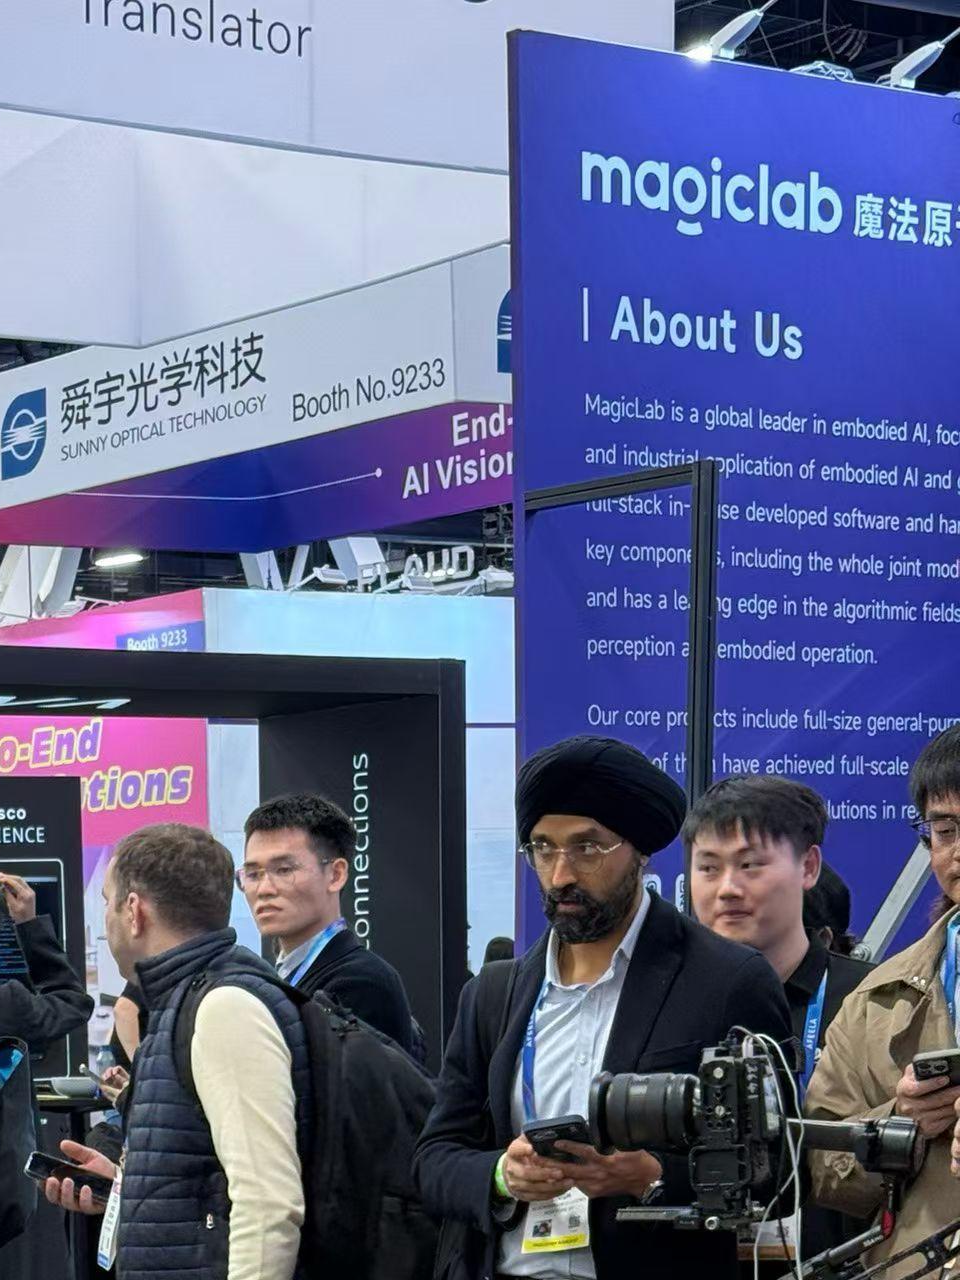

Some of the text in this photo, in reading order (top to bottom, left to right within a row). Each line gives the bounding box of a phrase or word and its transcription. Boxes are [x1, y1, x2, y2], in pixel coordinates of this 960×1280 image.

[581, 150, 843, 236] magiclab
[852, 192, 960, 247] 魔法原
[609, 295, 804, 360] About Us
[60, 331, 267, 434] 舜宇光学科技
[292, 357, 446, 422] Booth No.9233
[60, 394, 268, 462] SUNNY OPTICAL TECHNOLOGY
[451, 403, 513, 447] End-
[585, 392, 666, 424] MagicLab
[671, 400, 684, 422] is
[690, 408, 699, 424] a
[704, 403, 754, 431] global
[759, 408, 808, 433] leader
[813, 413, 827, 436] in
[831, 417, 908, 442] embodied
[912, 422, 931, 446] AI,
[401, 462, 431, 499] AI
[585, 443, 617, 465] and
[623, 443, 699, 469] industrial
[705, 452, 794, 479] plication
[798, 458, 816, 480] of
[820, 461, 898, 486] embodied
[902, 466, 919, 488] AI
[923, 469, 952, 490] and
[585, 494, 663, 516] full-stack
[669, 494, 740, 520] in-se
[745, 501, 828, 531] developed
[833, 507, 900, 532] software
[905, 512, 934, 534] and
[585, 537, 615, 567] key
[620, 544, 726, 569] compones,
[731, 546, 802, 576] including
[807, 550, 834, 573] the
[838, 552, 884, 576] whole
[887, 554, 922, 582] joint
[586, 586, 960, 625] and has a leng edge in the algorithmic fields
[127, 628, 188, 651] Booth 9233
[587, 635, 676, 662] perception
[716, 639, 796, 661] embodied
[801, 642, 878, 668] operation.
[587, 703, 619, 727] Our
[624, 709, 661, 727] core
[666, 708, 737, 732] procts
[742, 707, 798, 730] include
[803, 708, 862, 731] full-size
[652, 751, 669, 772] of
[722, 752, 760, 774] have
[765, 753, 835, 775] achieved
[840, 754, 909, 776] full-scale
[80, 765, 193, 813] tions
[827, 799, 920, 820] lutions in re
[349, 752, 370, 950] onnections
[805, 1018, 818, 1050] AFEELA
